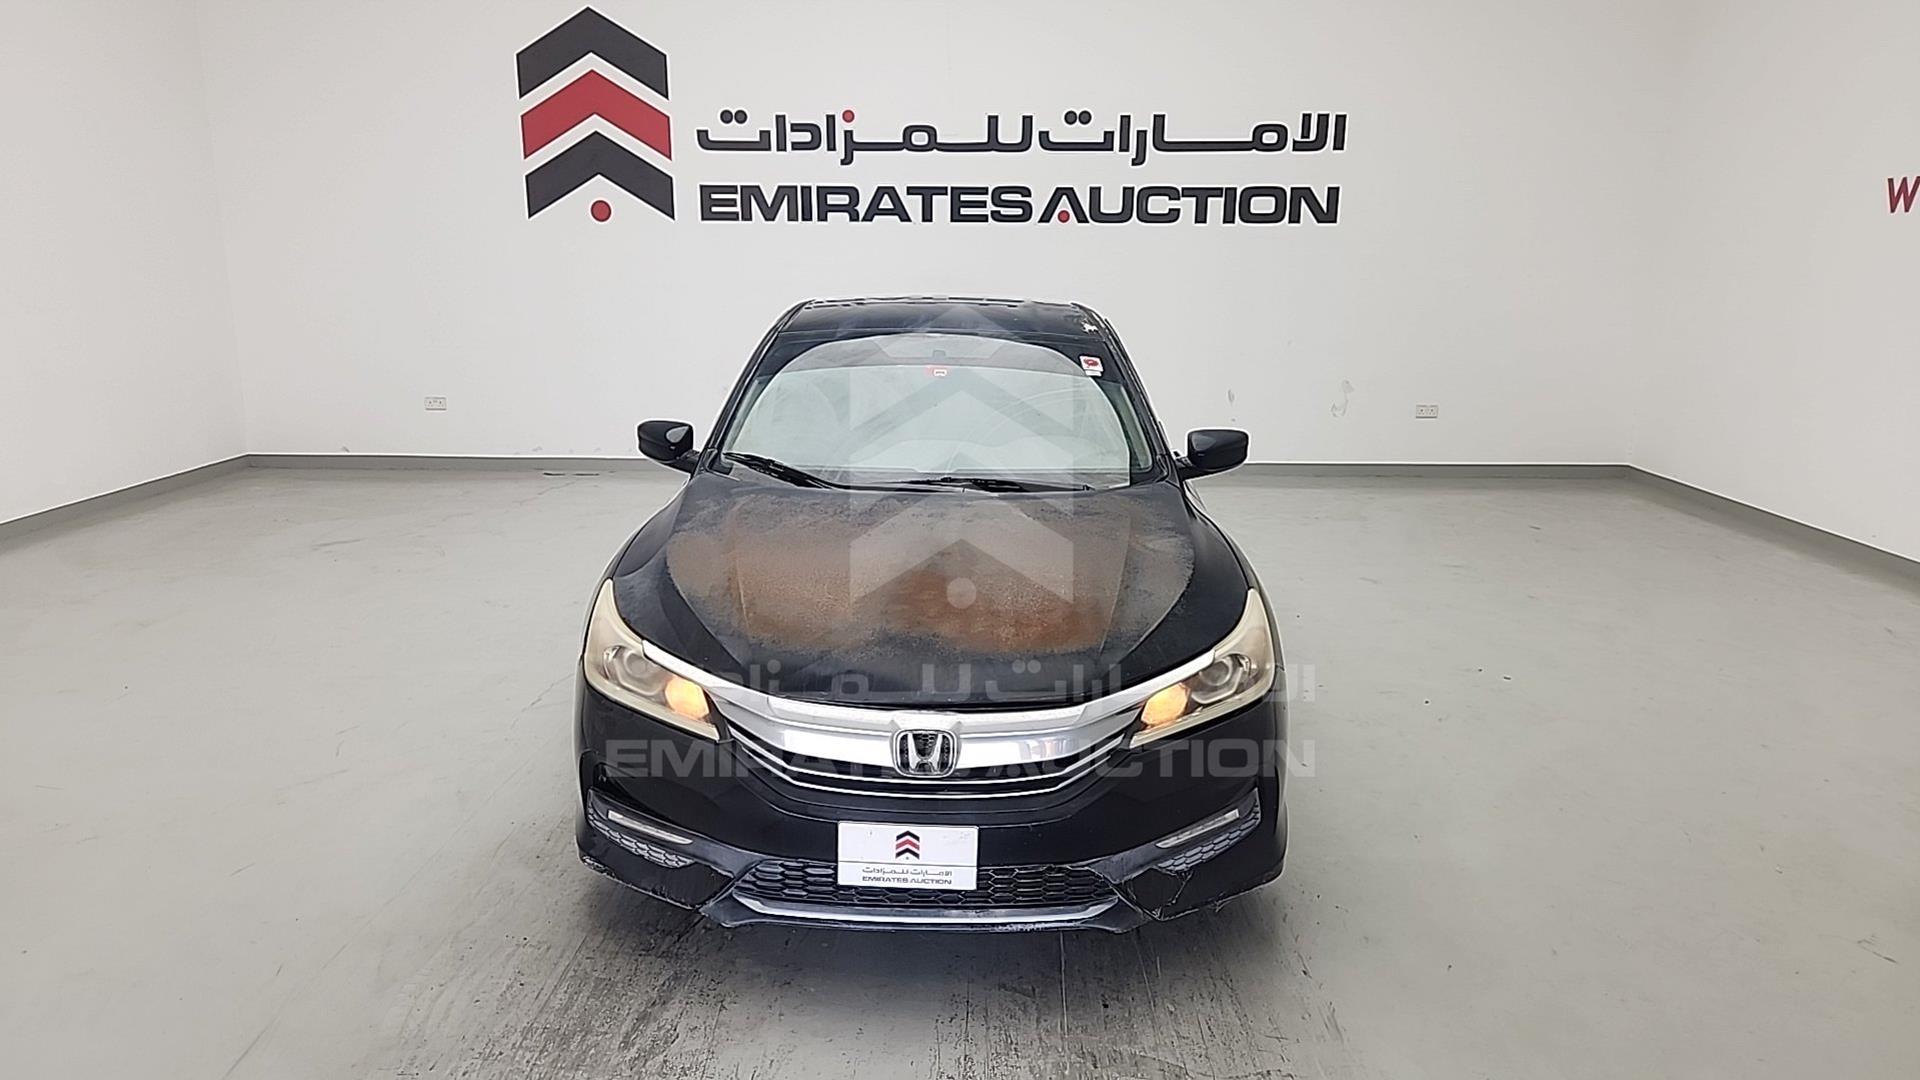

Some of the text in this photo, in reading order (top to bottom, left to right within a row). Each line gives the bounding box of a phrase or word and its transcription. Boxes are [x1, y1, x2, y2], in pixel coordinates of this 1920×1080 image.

[699, 184, 1340, 224] EMIRATES AUCTION
[910, 877, 952, 885] AUCTION
